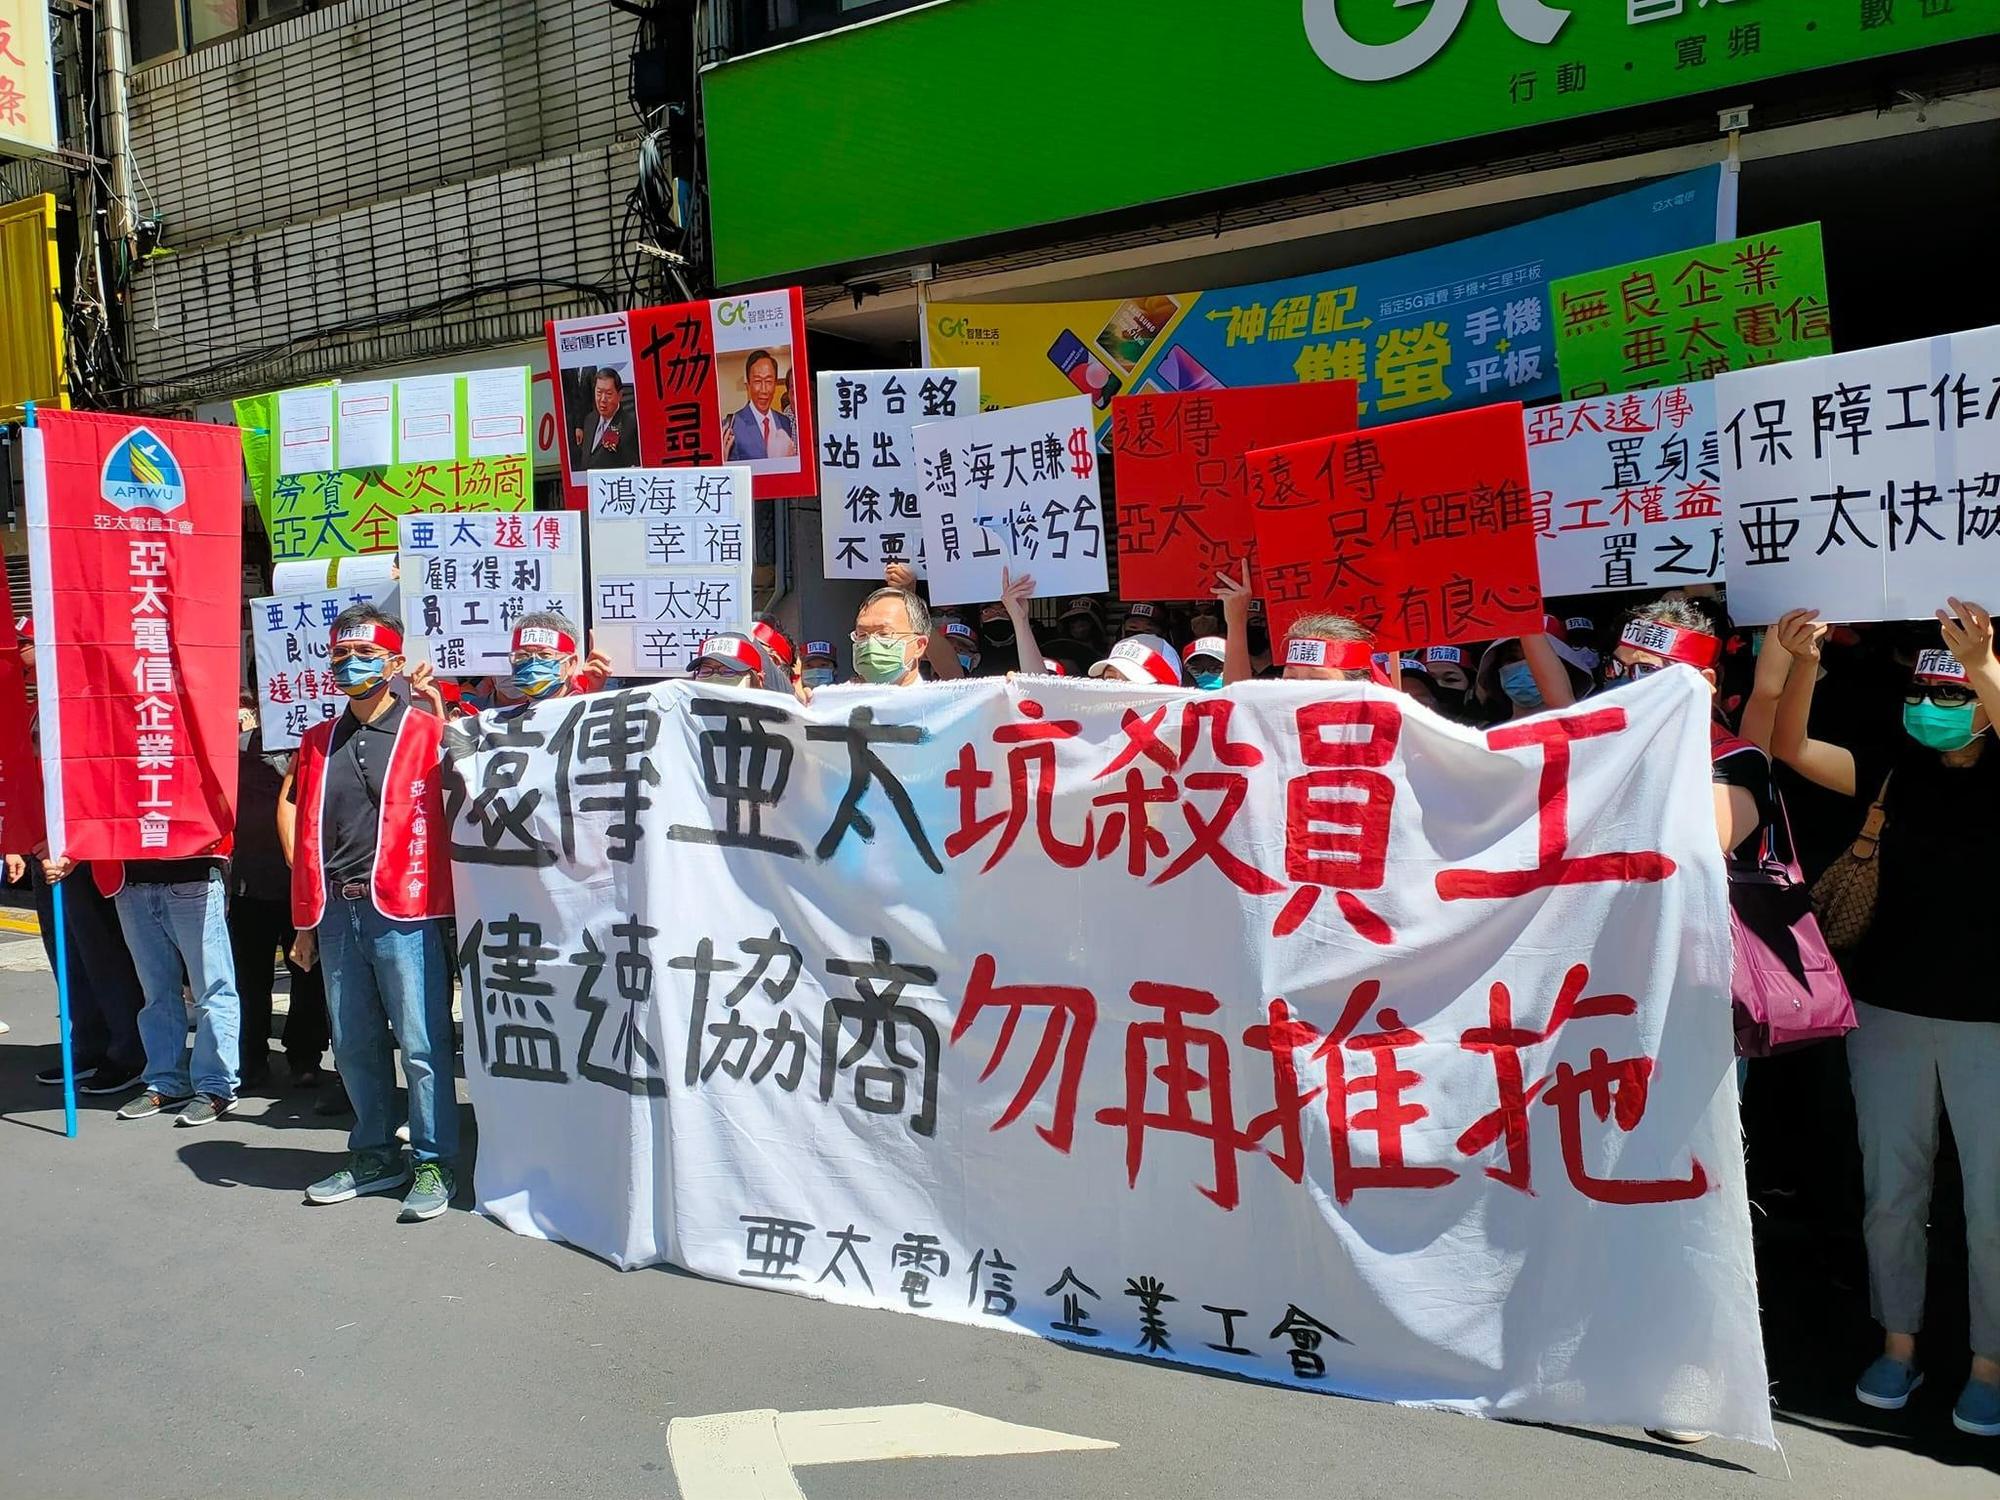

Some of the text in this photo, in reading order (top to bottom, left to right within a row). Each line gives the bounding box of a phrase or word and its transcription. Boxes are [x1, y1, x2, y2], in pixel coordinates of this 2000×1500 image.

[1509, 61, 1587, 104] 行動
[1675, 22, 1761, 70] 寬頻
[1561, 240, 1784, 337] 無良企業
[1464, 296, 1542, 346] 手機
[640, 312, 715, 467] 協尋
[1465, 345, 1543, 394] 平板
[836, 375, 958, 420] 郭台銘
[1528, 387, 1694, 446] 亞太遠傳
[822, 431, 917, 469] 站出
[1117, 397, 1223, 459] 遠傳
[114, 486, 173, 500] APTWU
[272, 454, 528, 513] 勞資八次協商
[599, 475, 732, 516] 鴻海好
[1251, 438, 1386, 511] 遠傳
[94, 514, 193, 534] 亞太電信工會
[1118, 495, 1215, 556] 亞太
[1328, 479, 1533, 550] 只有距離
[1531, 478, 1722, 540] 員工權益
[647, 522, 742, 563] 幸福
[836, 532, 928, 570] 不要
[600, 581, 732, 621] 亞太好
[1262, 552, 1385, 605] 亞太
[523, 628, 556, 646] 抗議
[1289, 640, 1319, 662] 抗議
[1623, 621, 1671, 649] 抗議
[1918, 649, 1963, 676] 抗議
[128, 541, 175, 849] 亞太電信企業工會
[406, 780, 427, 898] 亞太電信工會
[459, 912, 1709, 1212] 儘速協商勿再推拖
